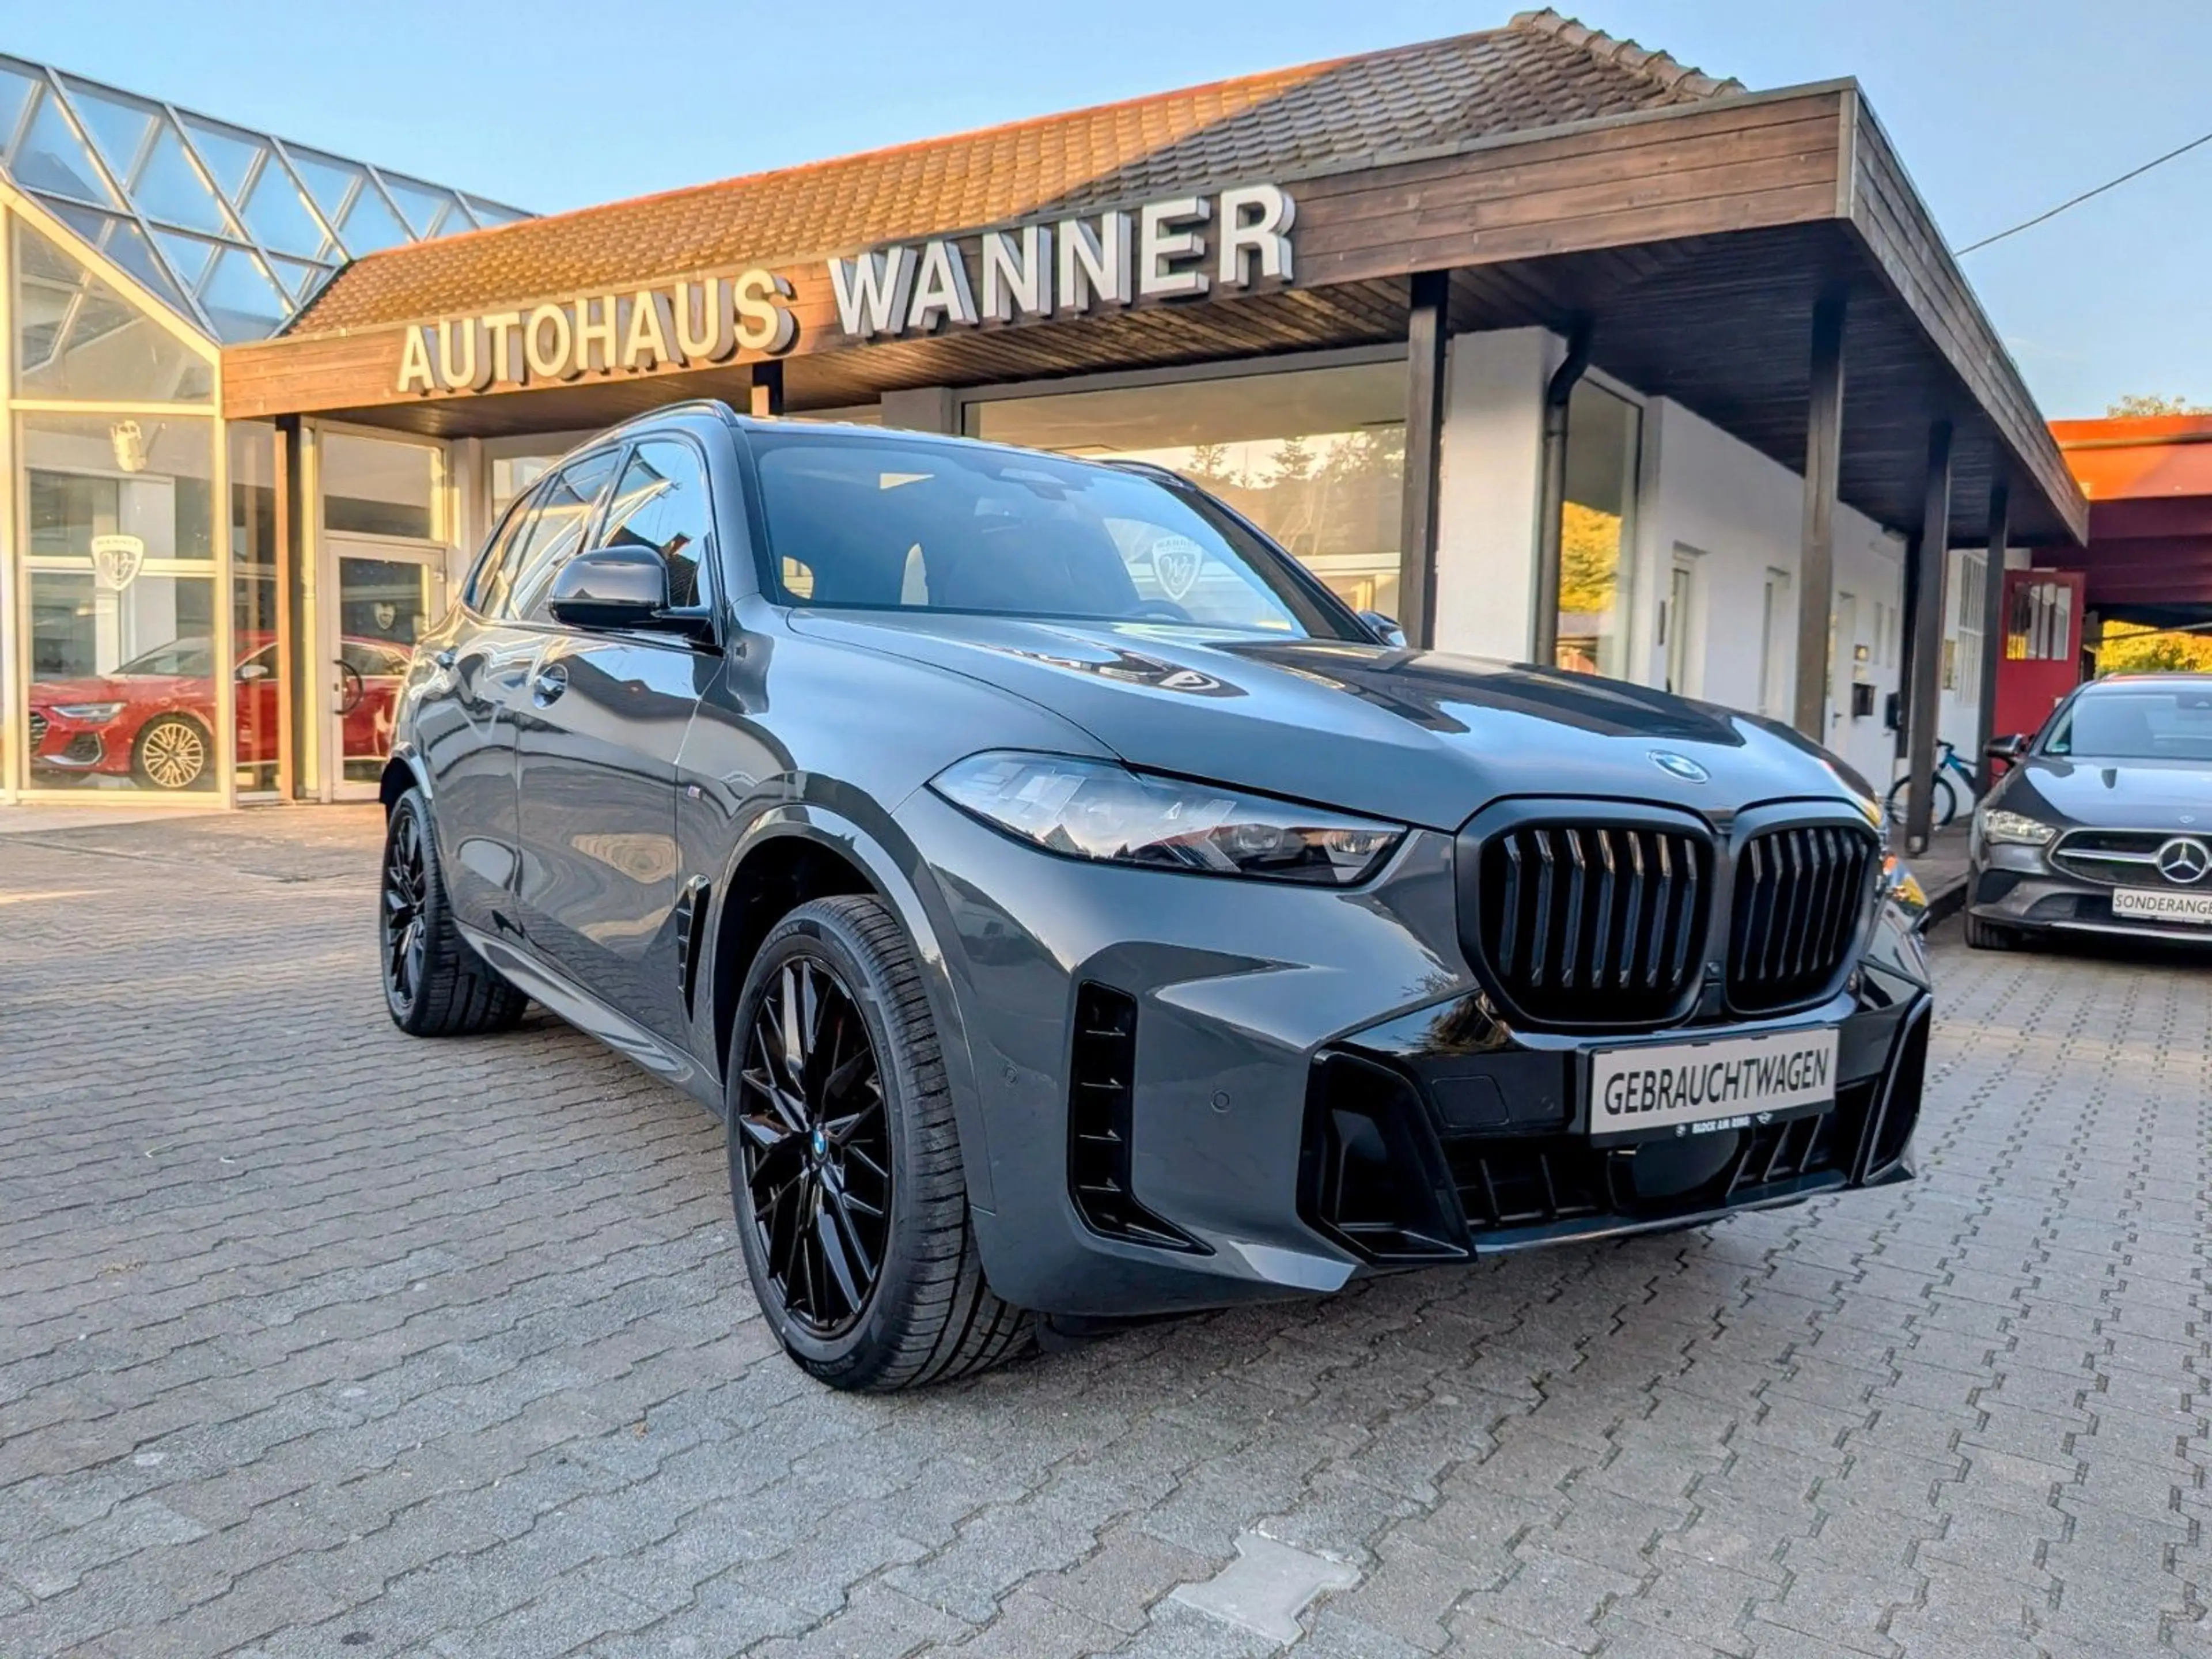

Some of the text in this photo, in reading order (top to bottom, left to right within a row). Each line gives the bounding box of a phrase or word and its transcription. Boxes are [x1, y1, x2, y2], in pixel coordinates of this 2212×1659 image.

[396, 183, 1295, 394] AUTOHAUS WANNER
[1604, 1048, 1828, 1115] GEBRAUCHTWAGEN
